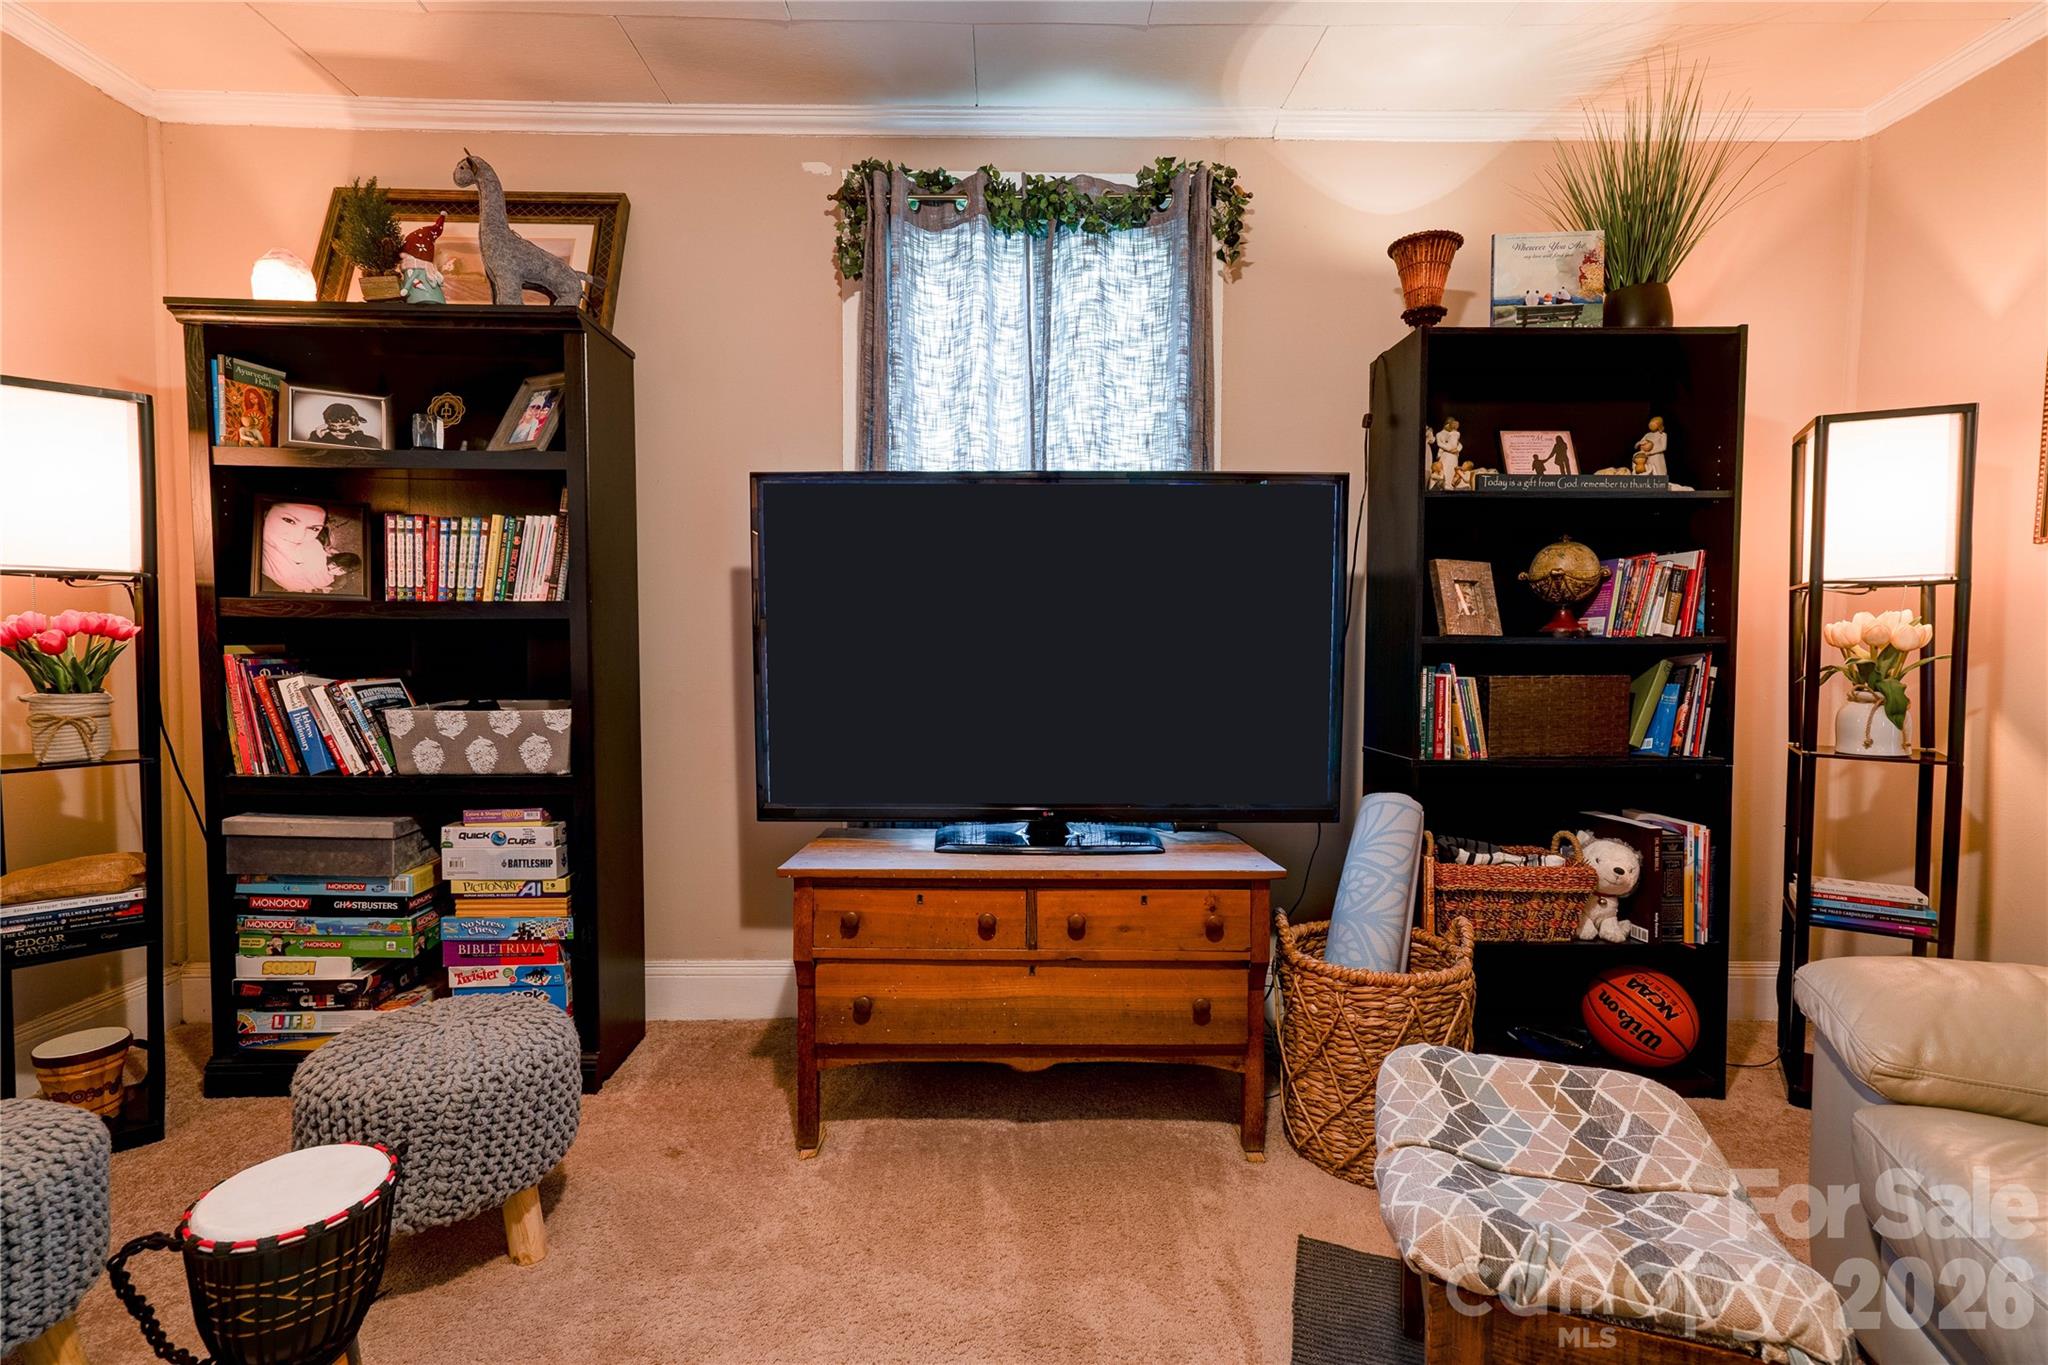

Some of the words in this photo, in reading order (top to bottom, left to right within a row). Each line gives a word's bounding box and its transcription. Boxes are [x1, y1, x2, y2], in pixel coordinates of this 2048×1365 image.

[1512, 243, 1546, 252] Wherever
[1549, 242, 1566, 251] You
[1568, 240, 1587, 250] Are
[235, 366, 273, 380] Ayurvedic
[255, 378, 279, 391] Healing
[1482, 475, 1508, 490] Today
[1509, 478, 1515, 487] is
[1523, 476, 1537, 490] gift
[1538, 477, 1556, 488] from
[1580, 478, 1618, 489] remember
[1620, 480, 1628, 488] to
[1629, 478, 1652, 489] thank
[1653, 479, 1667, 489] him
[301, 710, 314, 738] Hebrew
[293, 712, 309, 751] Dictionary
[507, 859, 554, 868] BATTLESHIP
[463, 881, 517, 892] PICTIONARY
[518, 881, 542, 896] AI
[252, 898, 309, 908] MONOPOLY
[58, 910, 90, 918] STILLNESS
[246, 920, 295, 929] MONOPOLY
[468, 926, 499, 936] Chess
[474, 919, 506, 929] Stress
[15, 934, 65, 949] EDGAR
[14, 943, 60, 957] CAYCE
[458, 944, 497, 955] BIBLE
[497, 943, 545, 954] TRIVIA
[262, 961, 317, 976] SORRY!
[454, 968, 499, 985] Twister
[299, 994, 336, 1008] CLUE
[1626, 977, 1679, 1021] NCAA
[272, 1013, 316, 1030] LIFE
[1599, 990, 1662, 1051] Wilson
